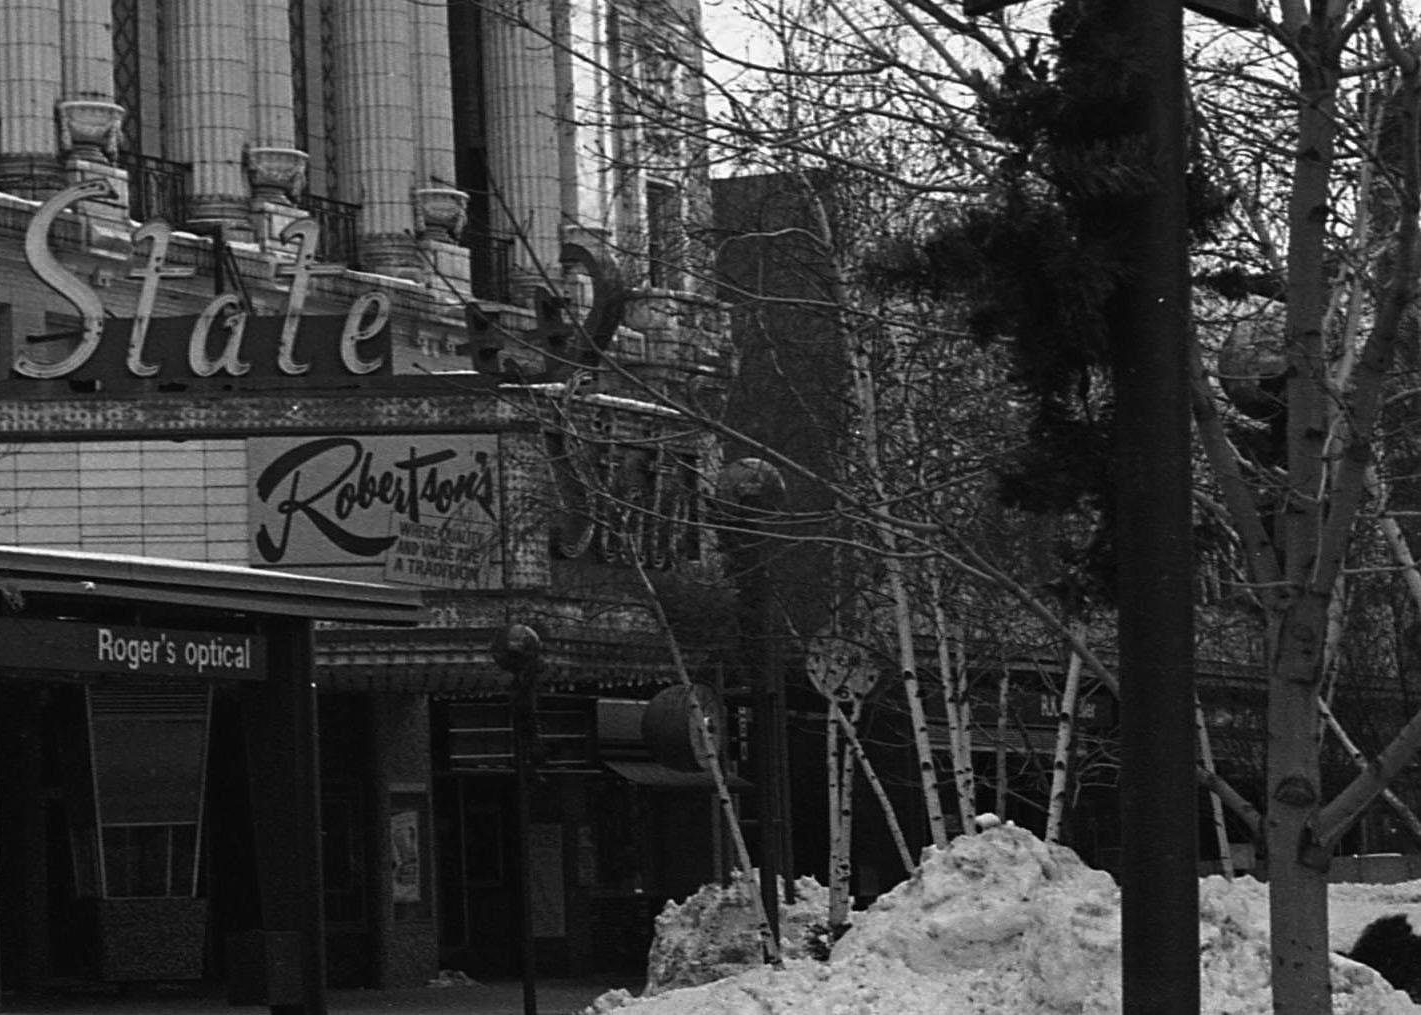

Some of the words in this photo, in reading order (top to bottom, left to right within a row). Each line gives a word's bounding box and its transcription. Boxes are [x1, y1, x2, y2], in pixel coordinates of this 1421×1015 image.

[13, 178, 390, 379] State
[256, 437, 496, 563] Robertson's
[397, 539, 420, 556] AND
[399, 520, 438, 540] WHERE
[394, 557, 403, 572] A
[408, 559, 480, 582] TRADITION
[98, 628, 176, 670] Roger's
[185, 636, 250, 673] optical
